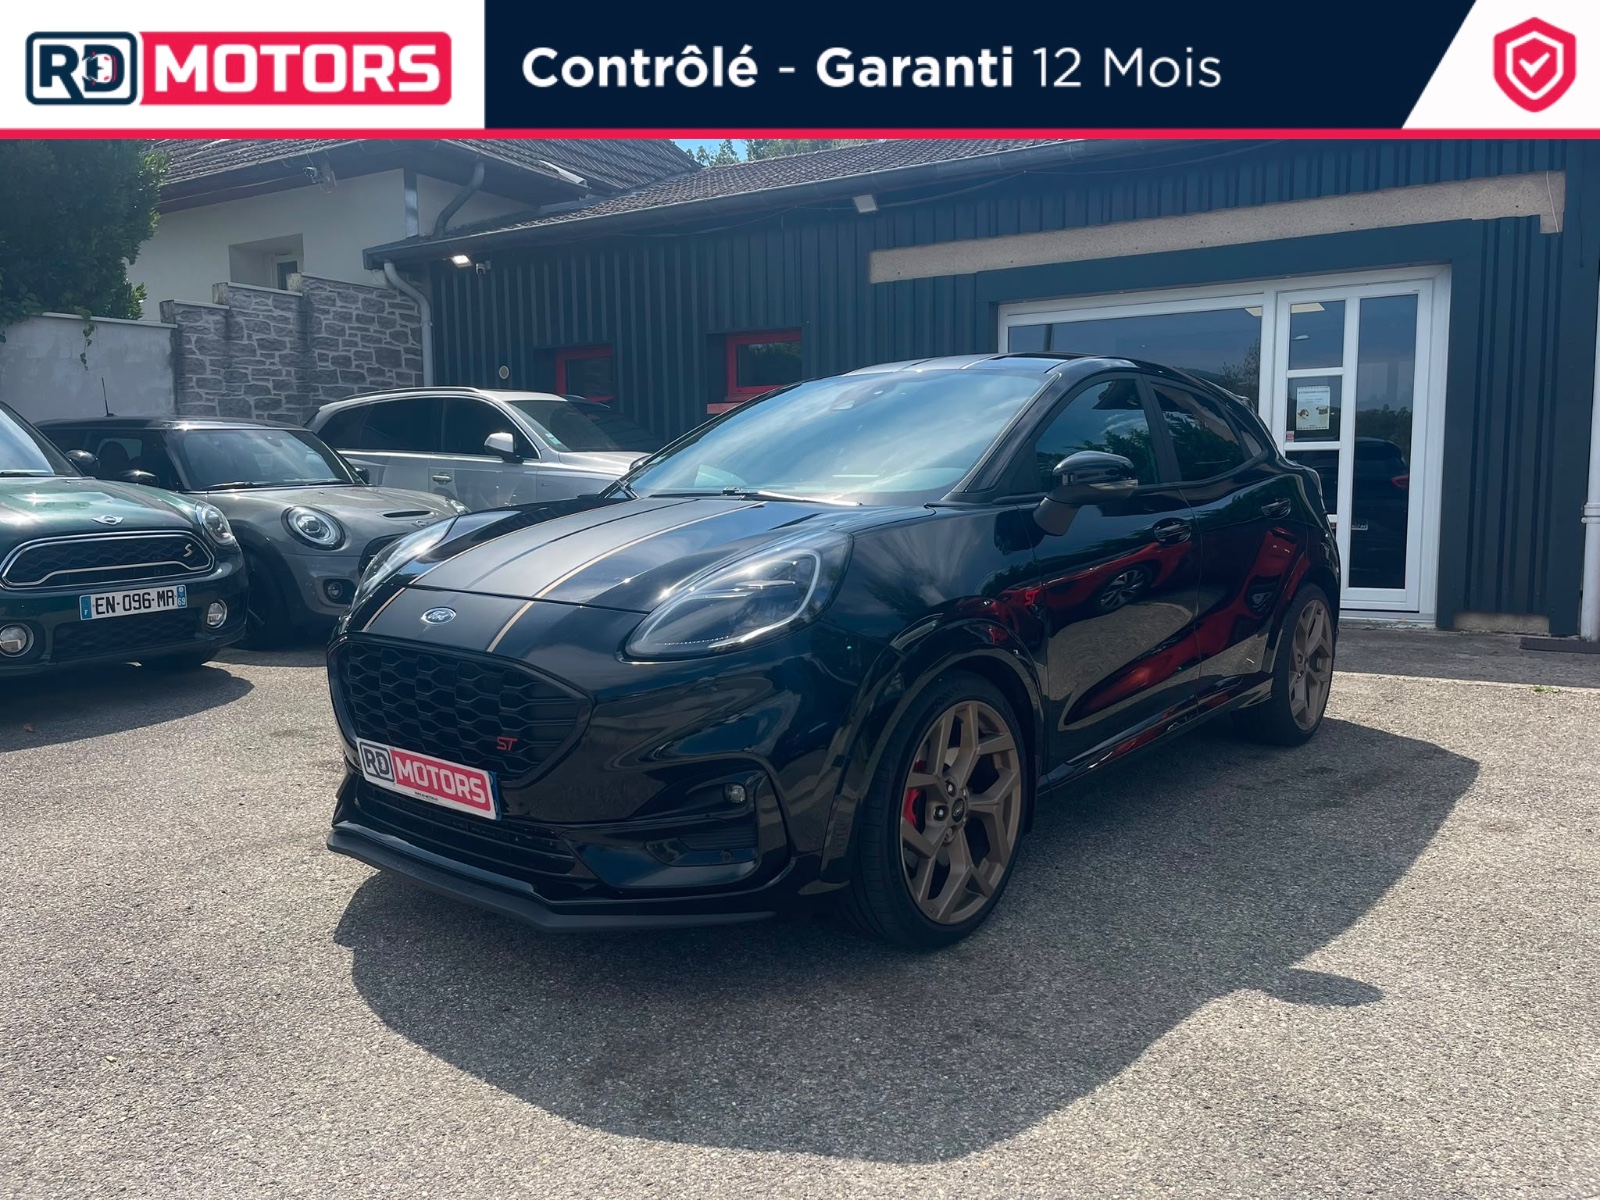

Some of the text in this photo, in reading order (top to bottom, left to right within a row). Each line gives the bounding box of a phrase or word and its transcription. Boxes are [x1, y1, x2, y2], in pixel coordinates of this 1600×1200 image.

[95, 589, 175, 615] EN-096-MR
[496, 736, 518, 750] ST
[363, 748, 486, 804] RD MOTORS
